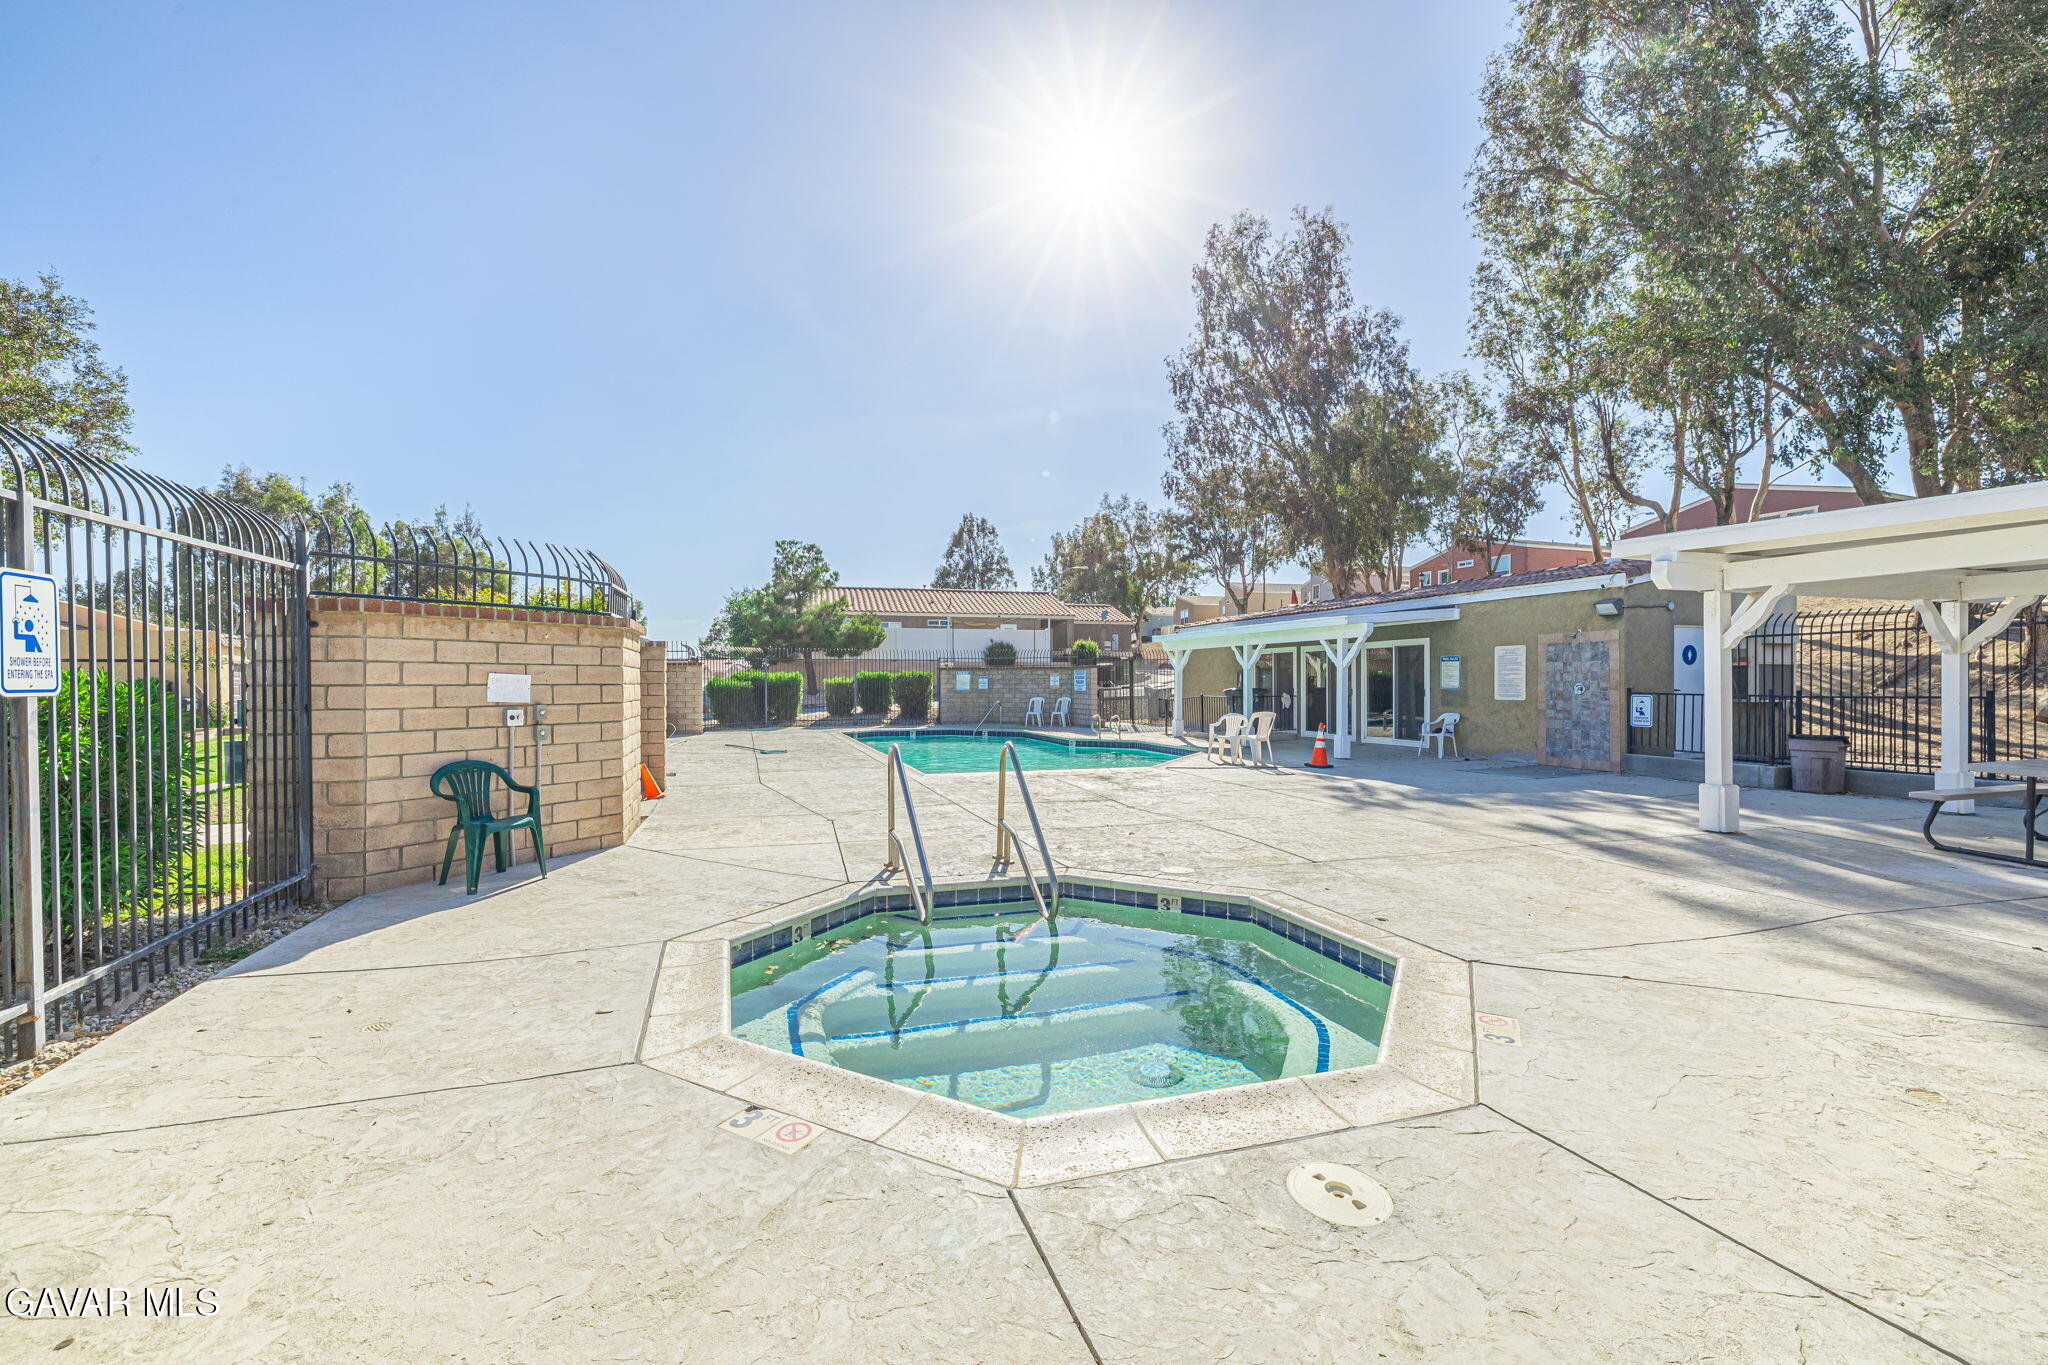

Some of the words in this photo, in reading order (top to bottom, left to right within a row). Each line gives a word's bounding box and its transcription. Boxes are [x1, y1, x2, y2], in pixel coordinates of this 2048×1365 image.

[9, 656, 32, 667] SHOWER
[33, 657, 51, 667] BEFORE
[7, 669, 33, 679] ENTERING
[34, 669, 43, 679] THE
[44, 669, 54, 679] SPA
[1160, 897, 1171, 911] 3
[794, 926, 804, 943] 3
[1483, 1033, 1516, 1044] 3
[729, 1110, 764, 1129] 3
